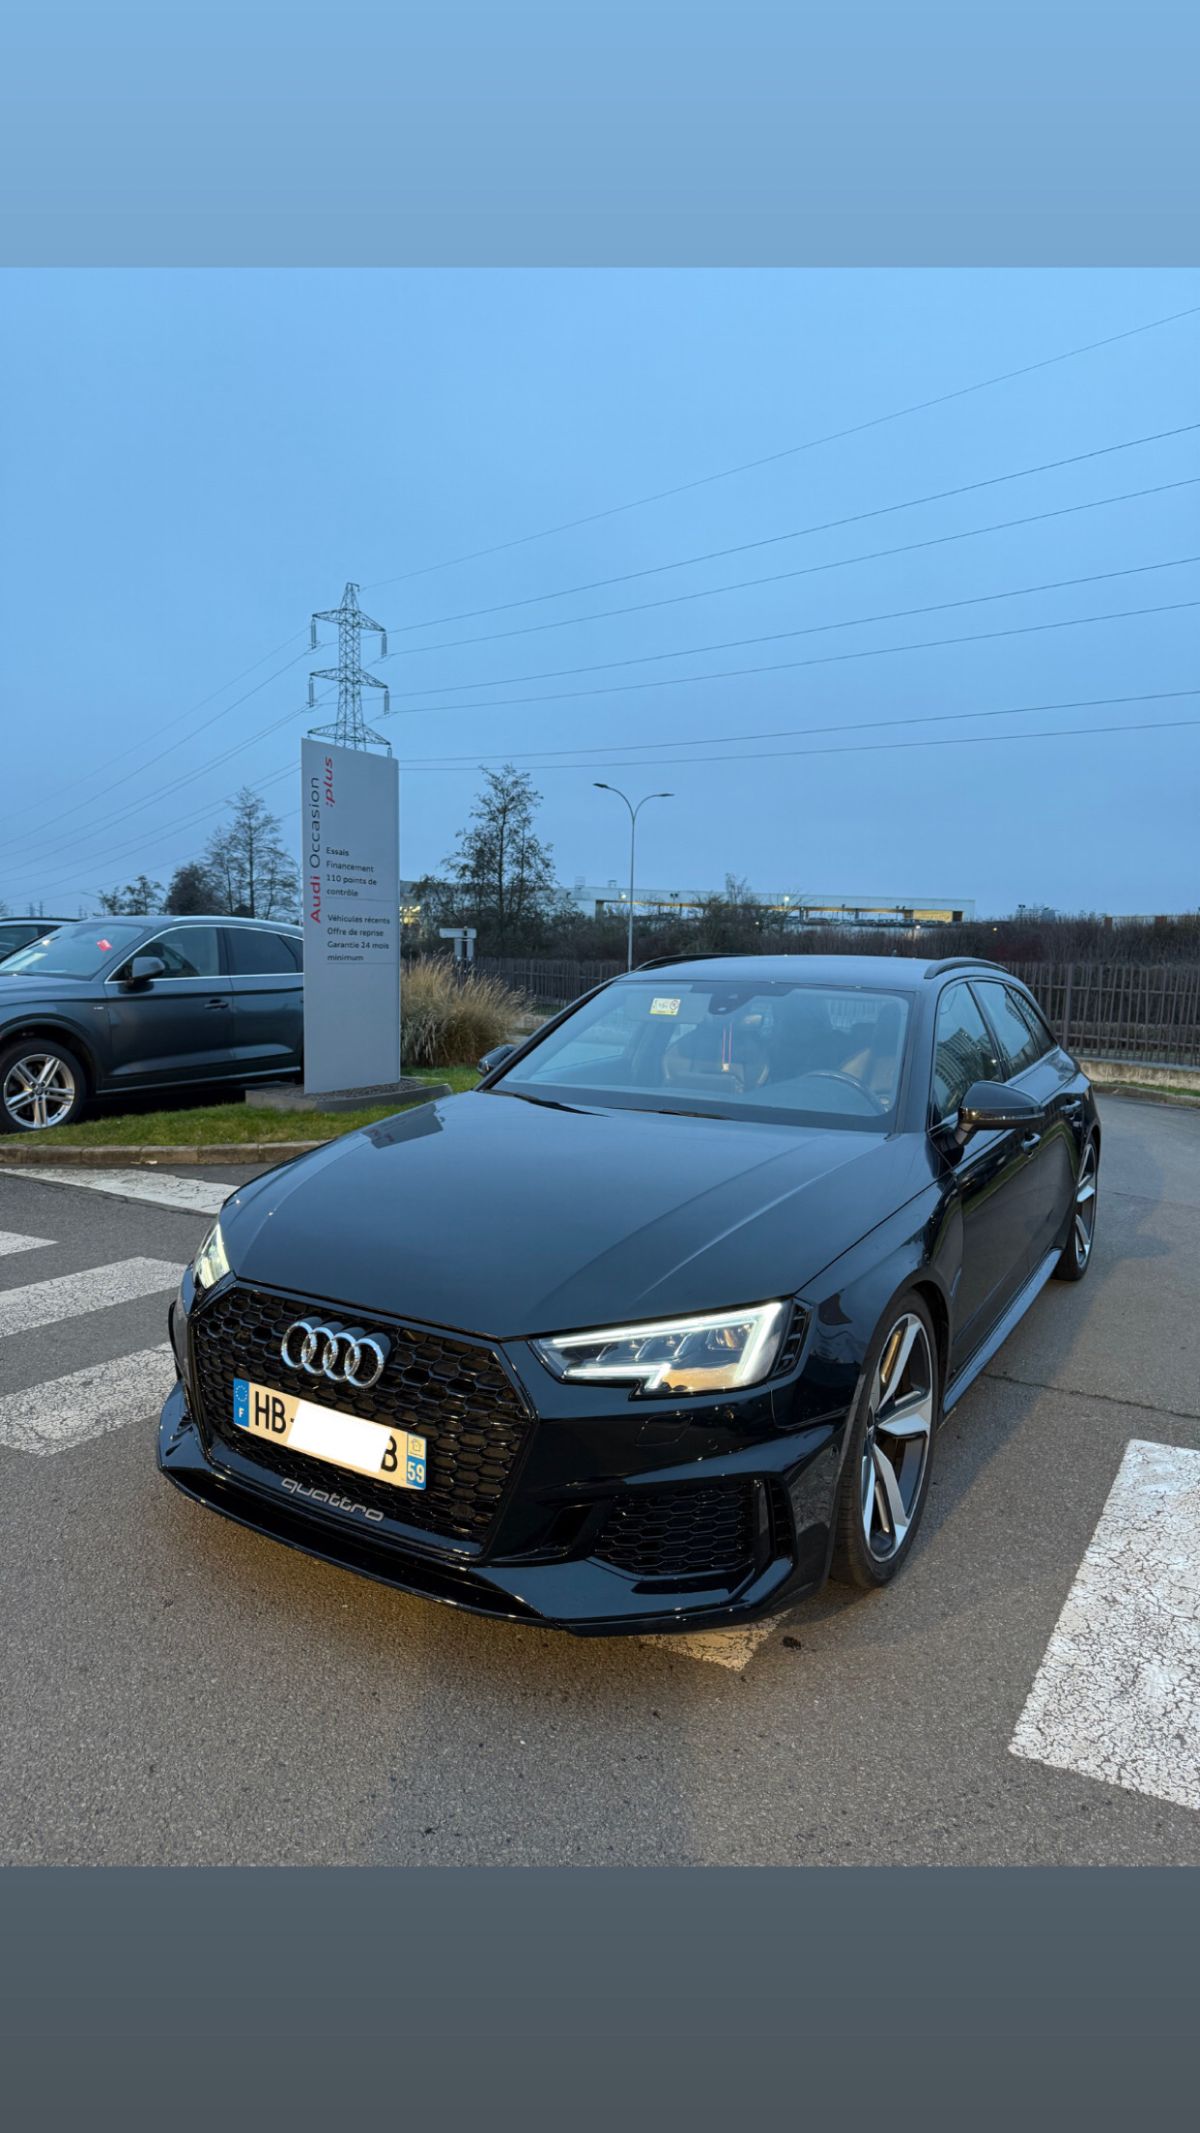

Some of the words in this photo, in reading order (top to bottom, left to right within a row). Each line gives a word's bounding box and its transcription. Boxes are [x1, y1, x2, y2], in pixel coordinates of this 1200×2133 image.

[309, 777, 321, 869] Occasion
[326, 846, 350, 857] Essais
[326, 860, 375, 873] Financement
[326, 874, 342, 883] 110
[342, 877, 367, 885] points
[310, 876, 321, 924] Audi
[327, 927, 347, 936] Offre
[348, 928, 358, 936] de
[327, 940, 360, 949] Garantie
[360, 941, 371, 949] 24
[327, 953, 364, 961] minimum
[238, 1407, 244, 1418] F
[407, 1461, 425, 1484] 59
[281, 1478, 384, 1522] quattro
